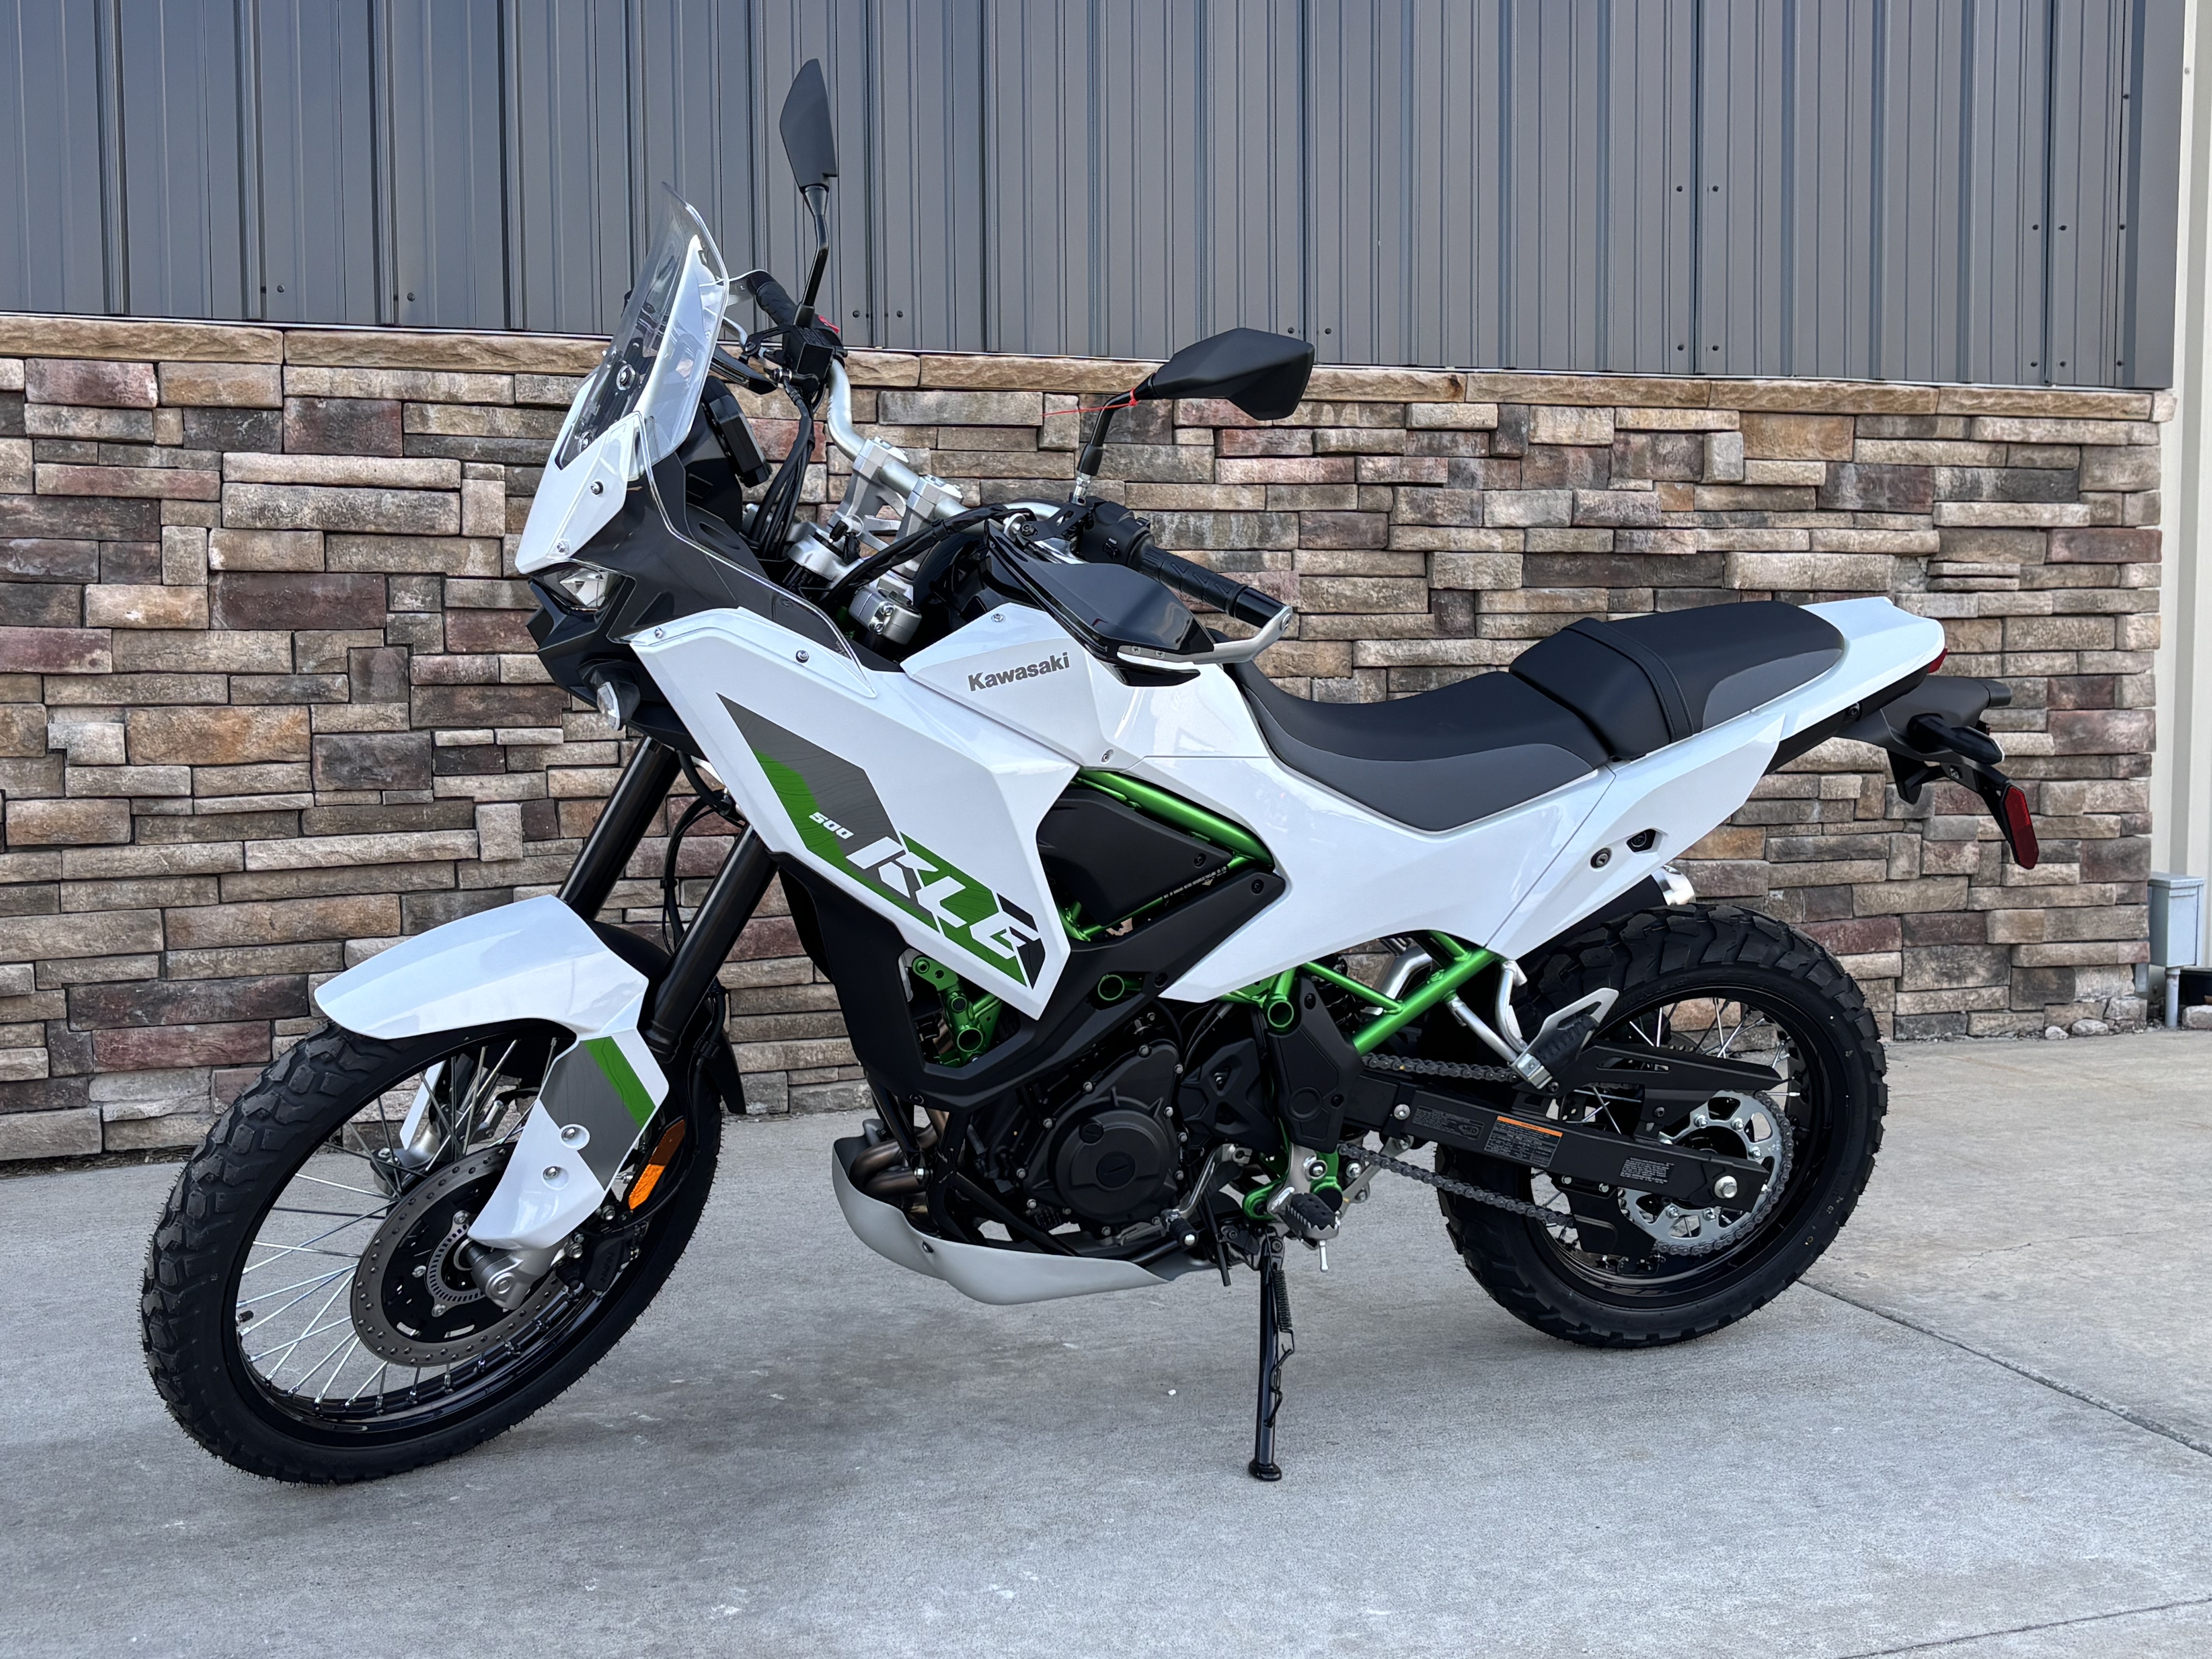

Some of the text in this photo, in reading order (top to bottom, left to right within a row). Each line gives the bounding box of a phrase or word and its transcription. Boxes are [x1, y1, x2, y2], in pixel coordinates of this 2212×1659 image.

[968, 652, 1070, 692] Kawasaki
[809, 812, 854, 840] 500
[845, 836, 1041, 959] KLE
